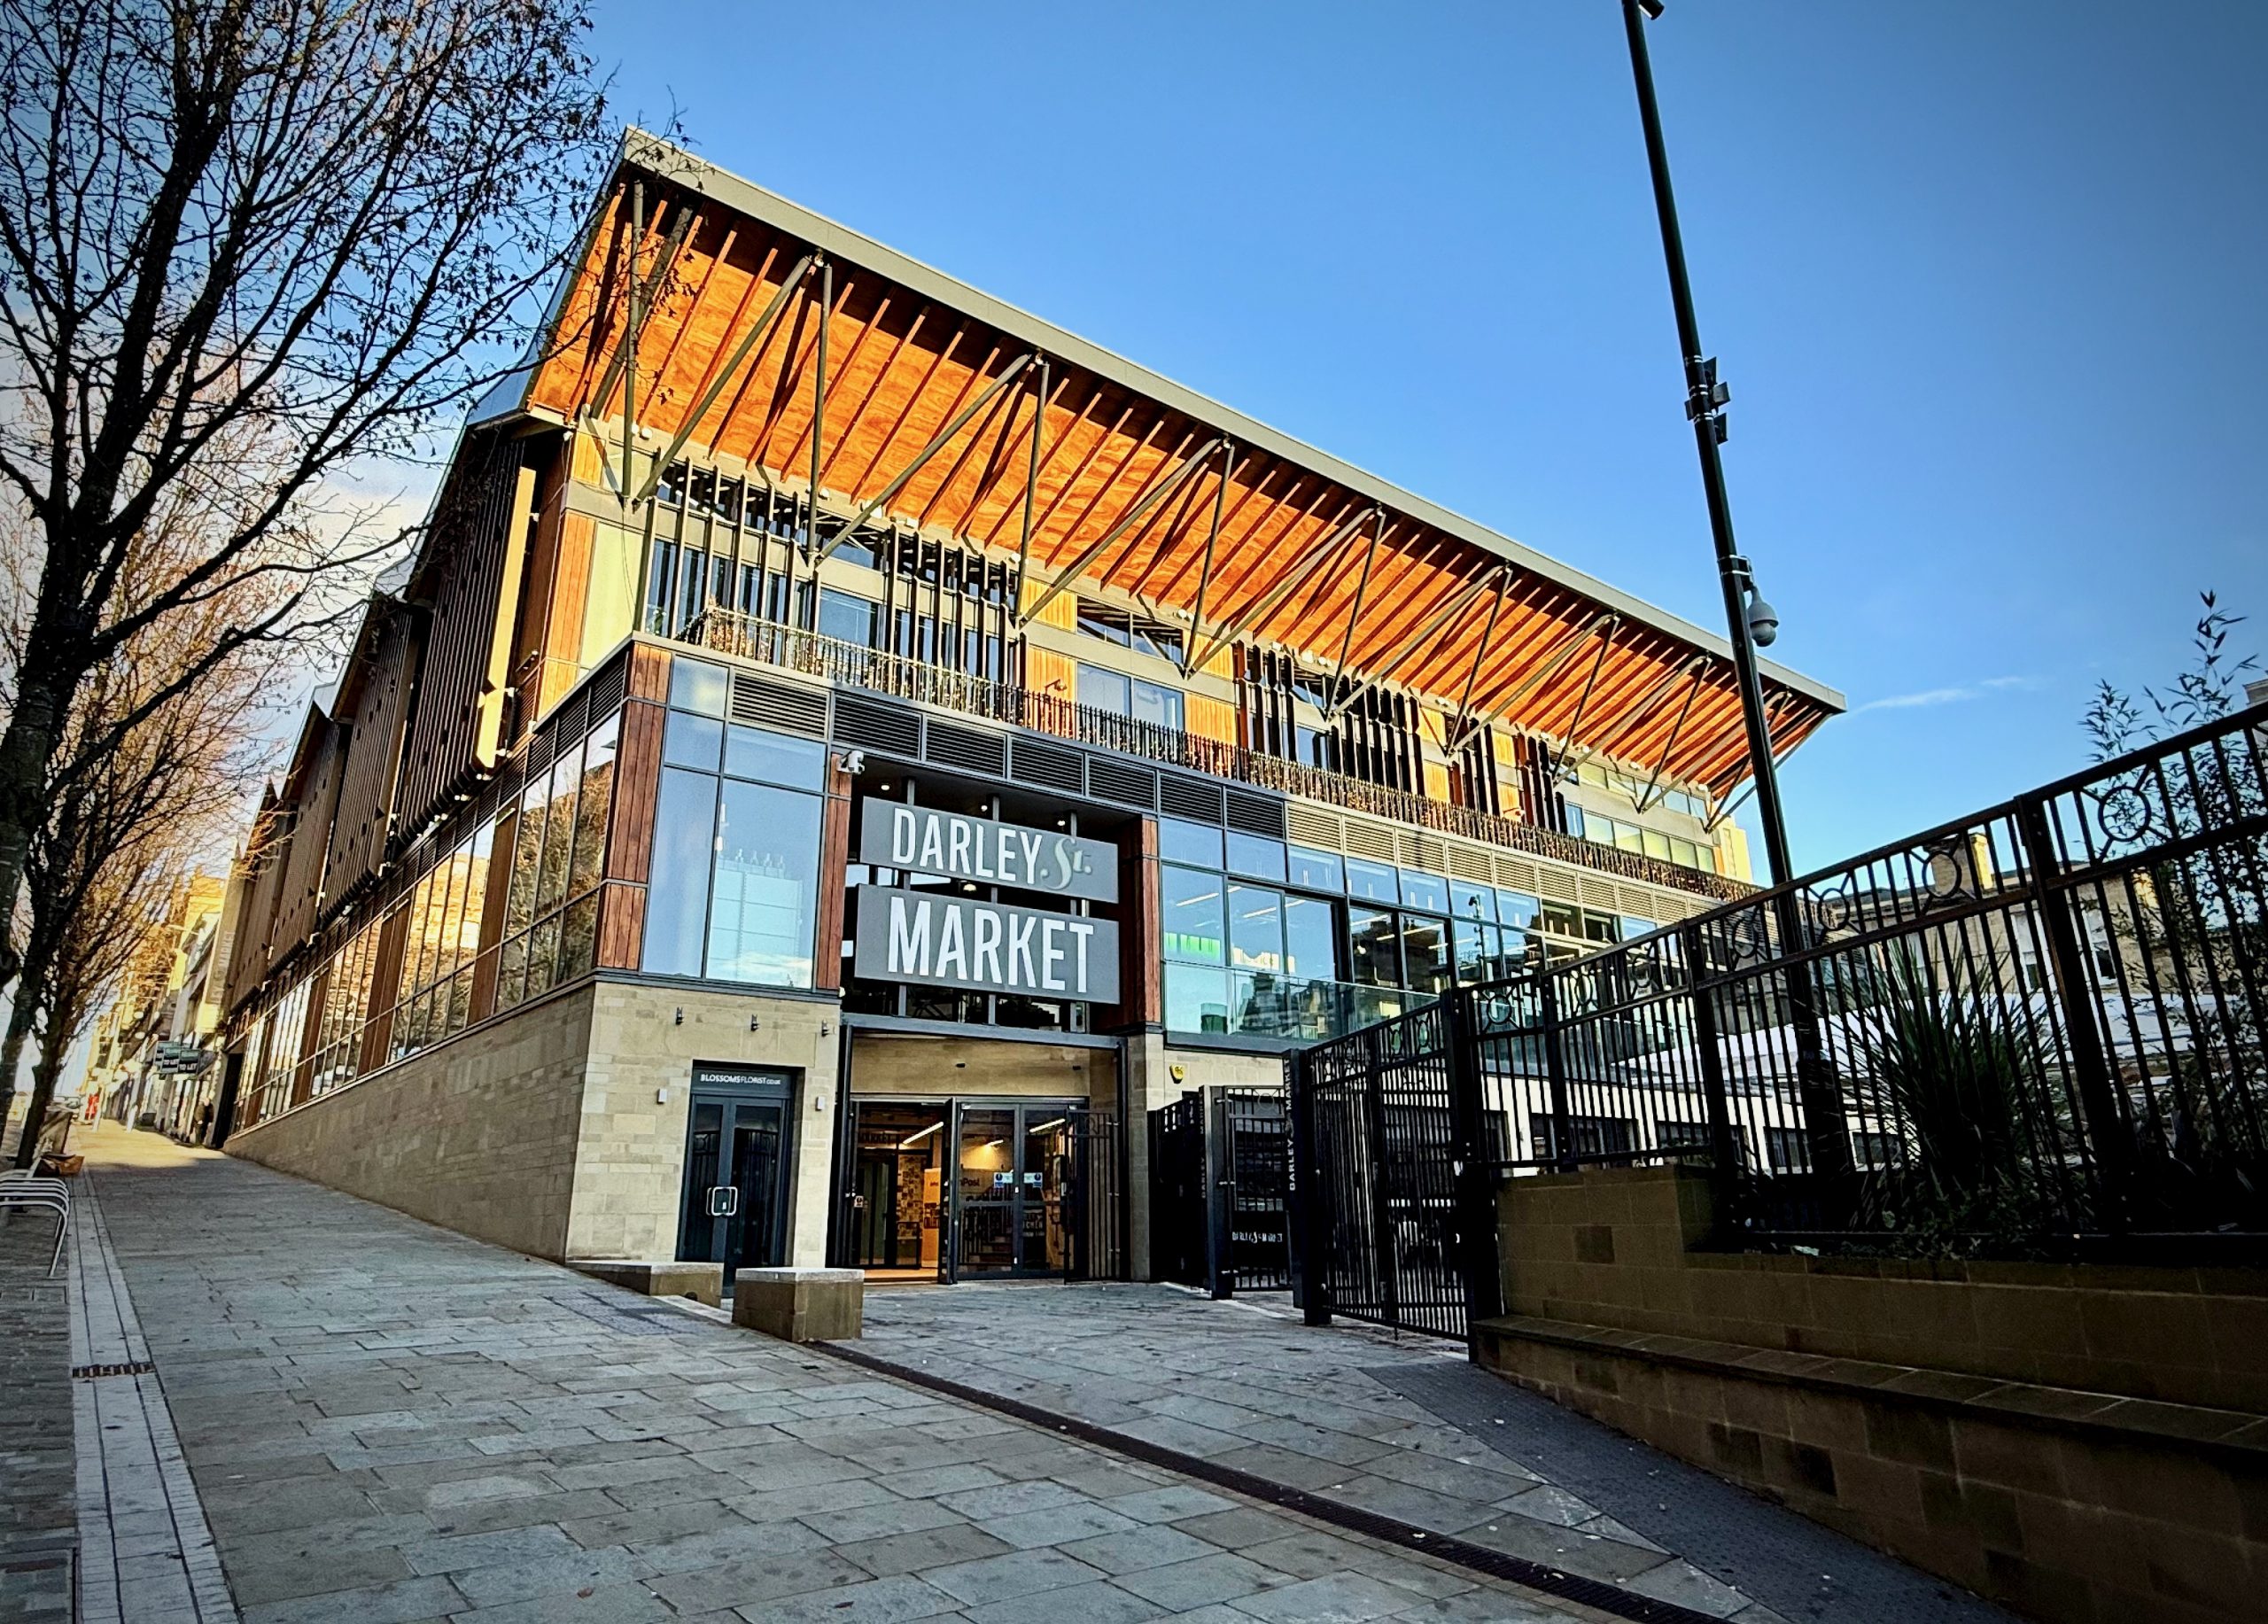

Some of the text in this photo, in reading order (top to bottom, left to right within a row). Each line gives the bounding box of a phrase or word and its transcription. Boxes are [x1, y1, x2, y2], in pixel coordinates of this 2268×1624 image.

[892, 807, 1042, 884] DARLEY
[888, 897, 1094, 993] MARKET
[1287, 1138, 1296, 1192] DARLEY
